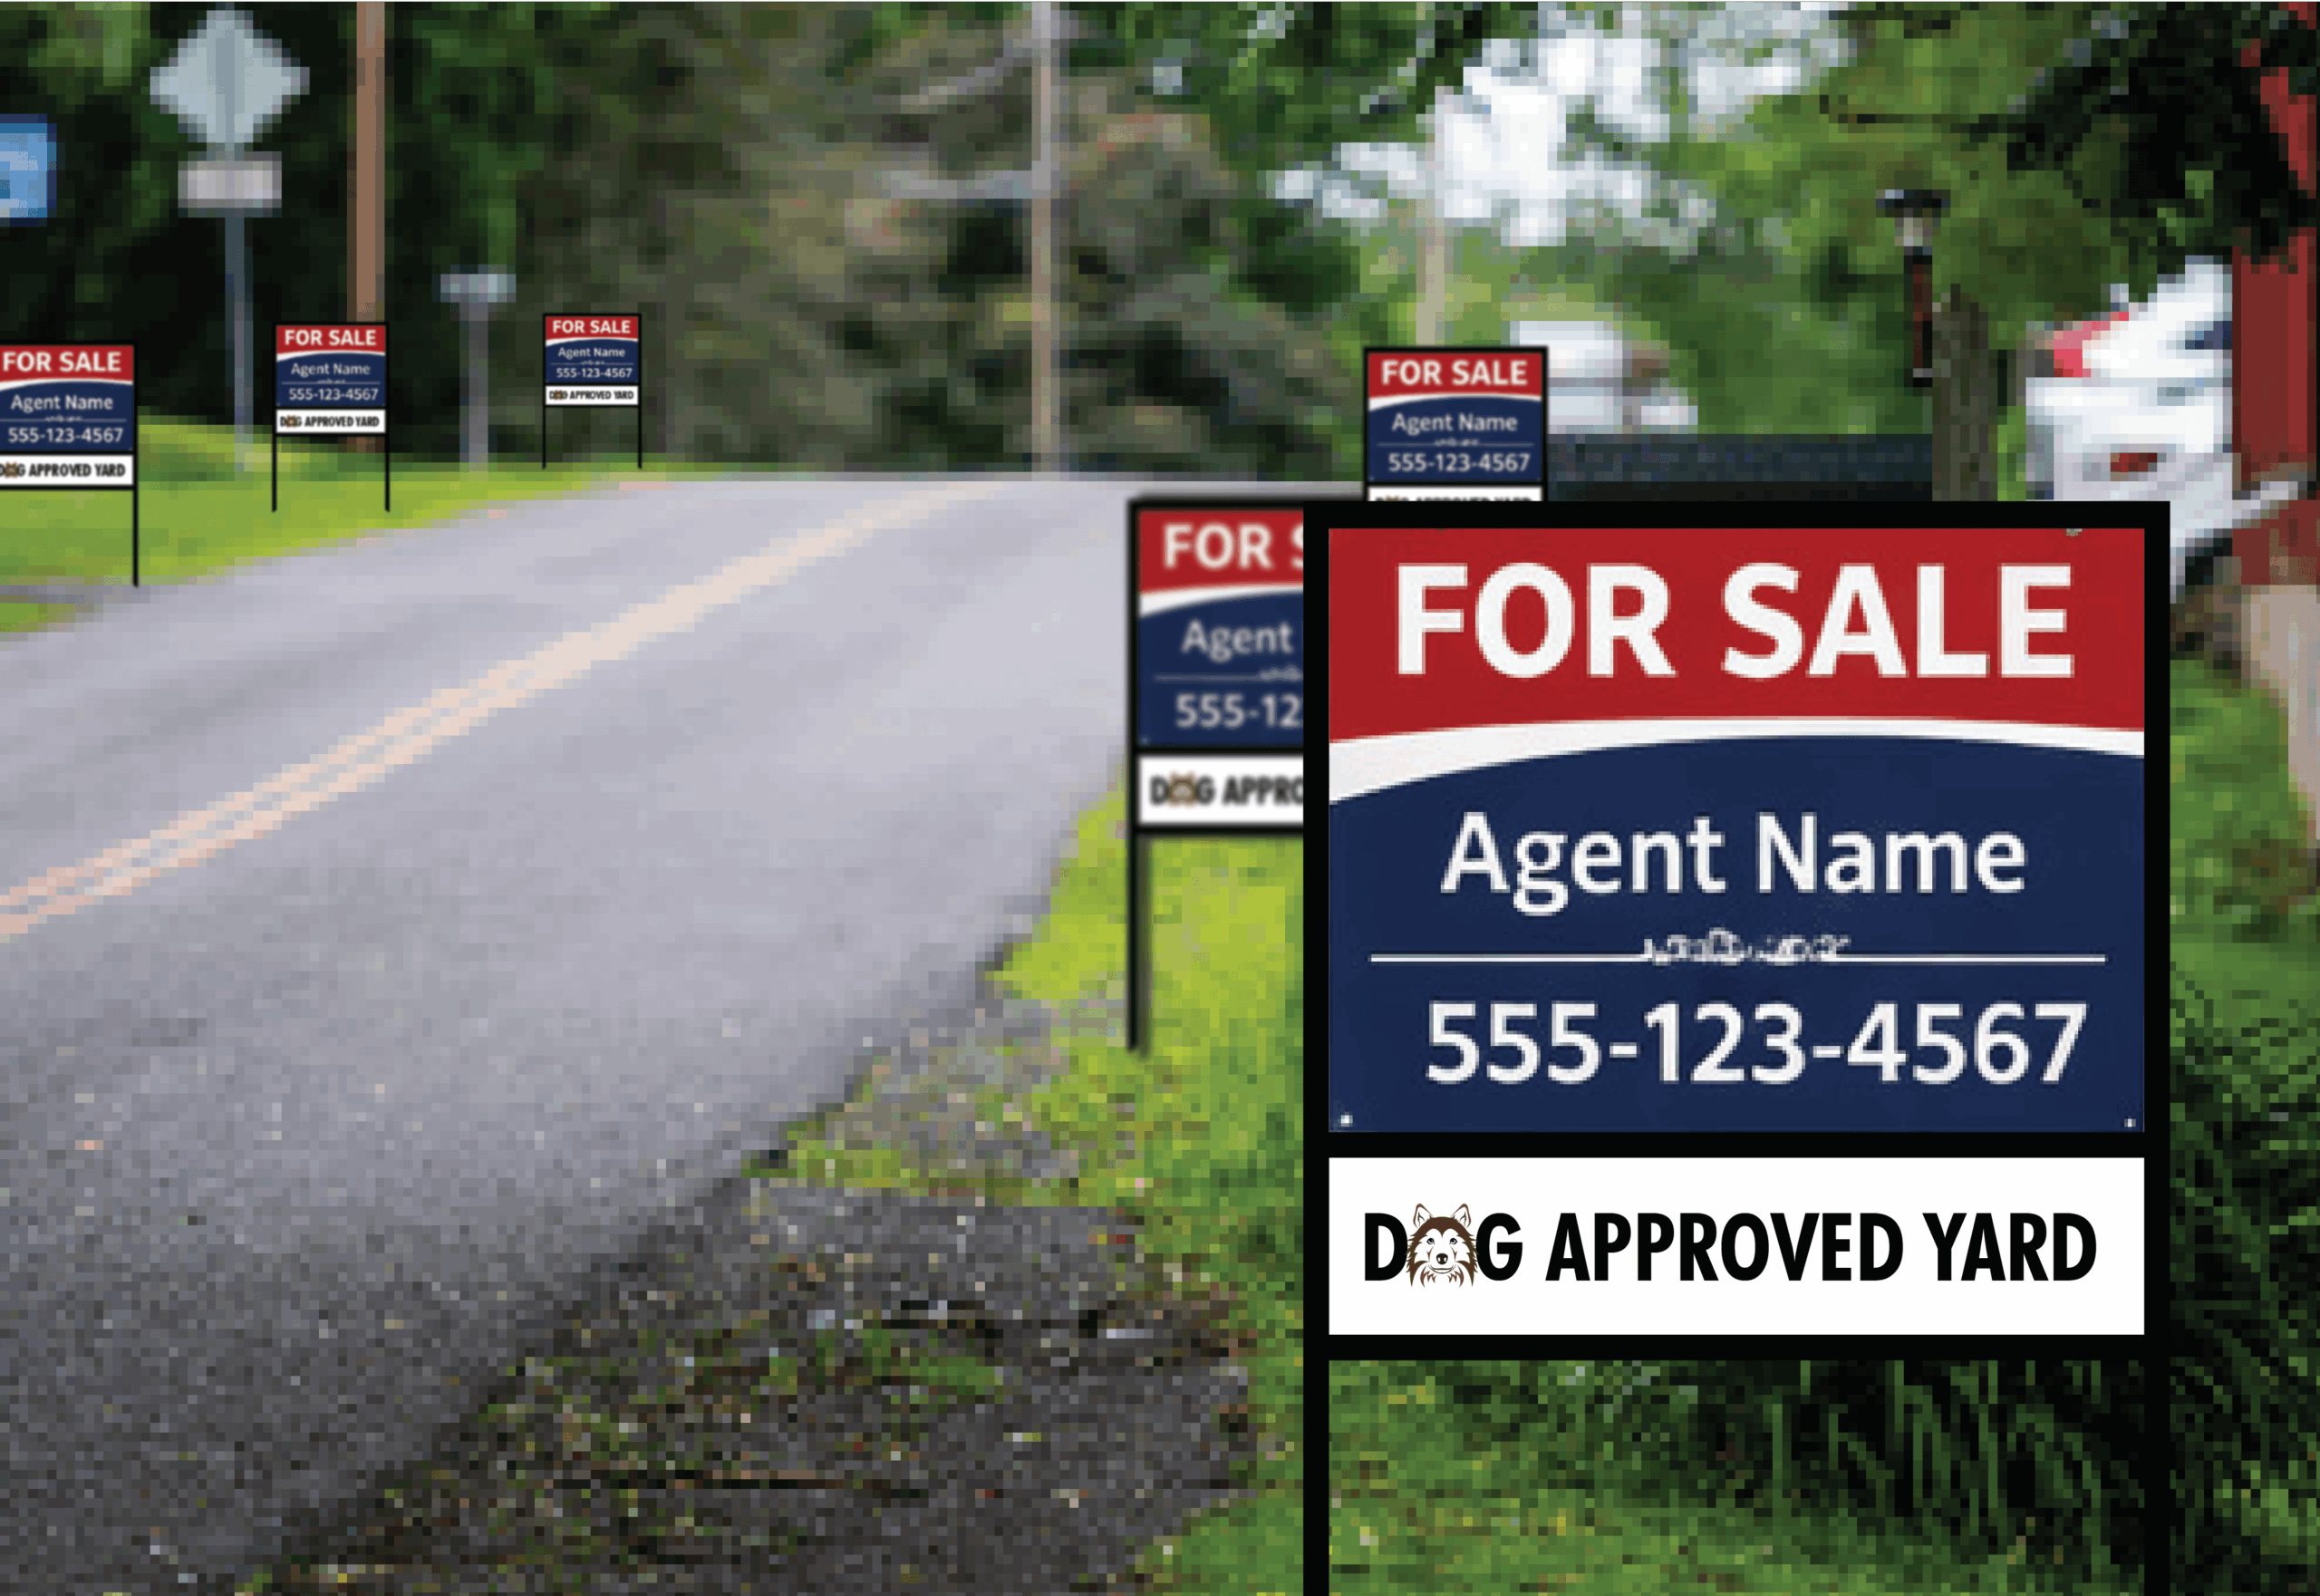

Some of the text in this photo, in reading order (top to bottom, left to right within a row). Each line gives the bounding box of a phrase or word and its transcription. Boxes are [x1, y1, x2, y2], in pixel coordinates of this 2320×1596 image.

[553, 320, 630, 334] FOR SALE
[285, 330, 376, 345] FOR SALE
[4, 352, 121, 372] FOR SALE
[558, 348, 624, 359] Agent Name
[292, 363, 370, 377] Agent Name
[557, 368, 632, 377] 555-123-4567
[1382, 360, 1527, 385] FOR SALE
[290, 389, 378, 400] 555-123-4567
[570, 391, 612, 400] APPROVED
[614, 391, 633, 400] YARD
[11, 395, 112, 413] Agent Name
[280, 416, 379, 427] DG APPROVED YARD
[1392, 413, 1517, 435] Agent Name
[9, 428, 123, 442] 555-123-4567
[0, 463, 125, 478] DG APPROVED YARD
[1389, 453, 1530, 471] 555-123-4567
[1165, 523, 1271, 569] FOR
[1398, 563, 2074, 678] FOR SALE
[1183, 620, 1291, 662] Agent
[1150, 775, 1215, 805] DG
[1441, 812, 2025, 915] Agent Name
[1426, 1001, 2086, 1084] 555-123-4567
[1365, 1204, 2096, 1287] DG APPROVED YARD
